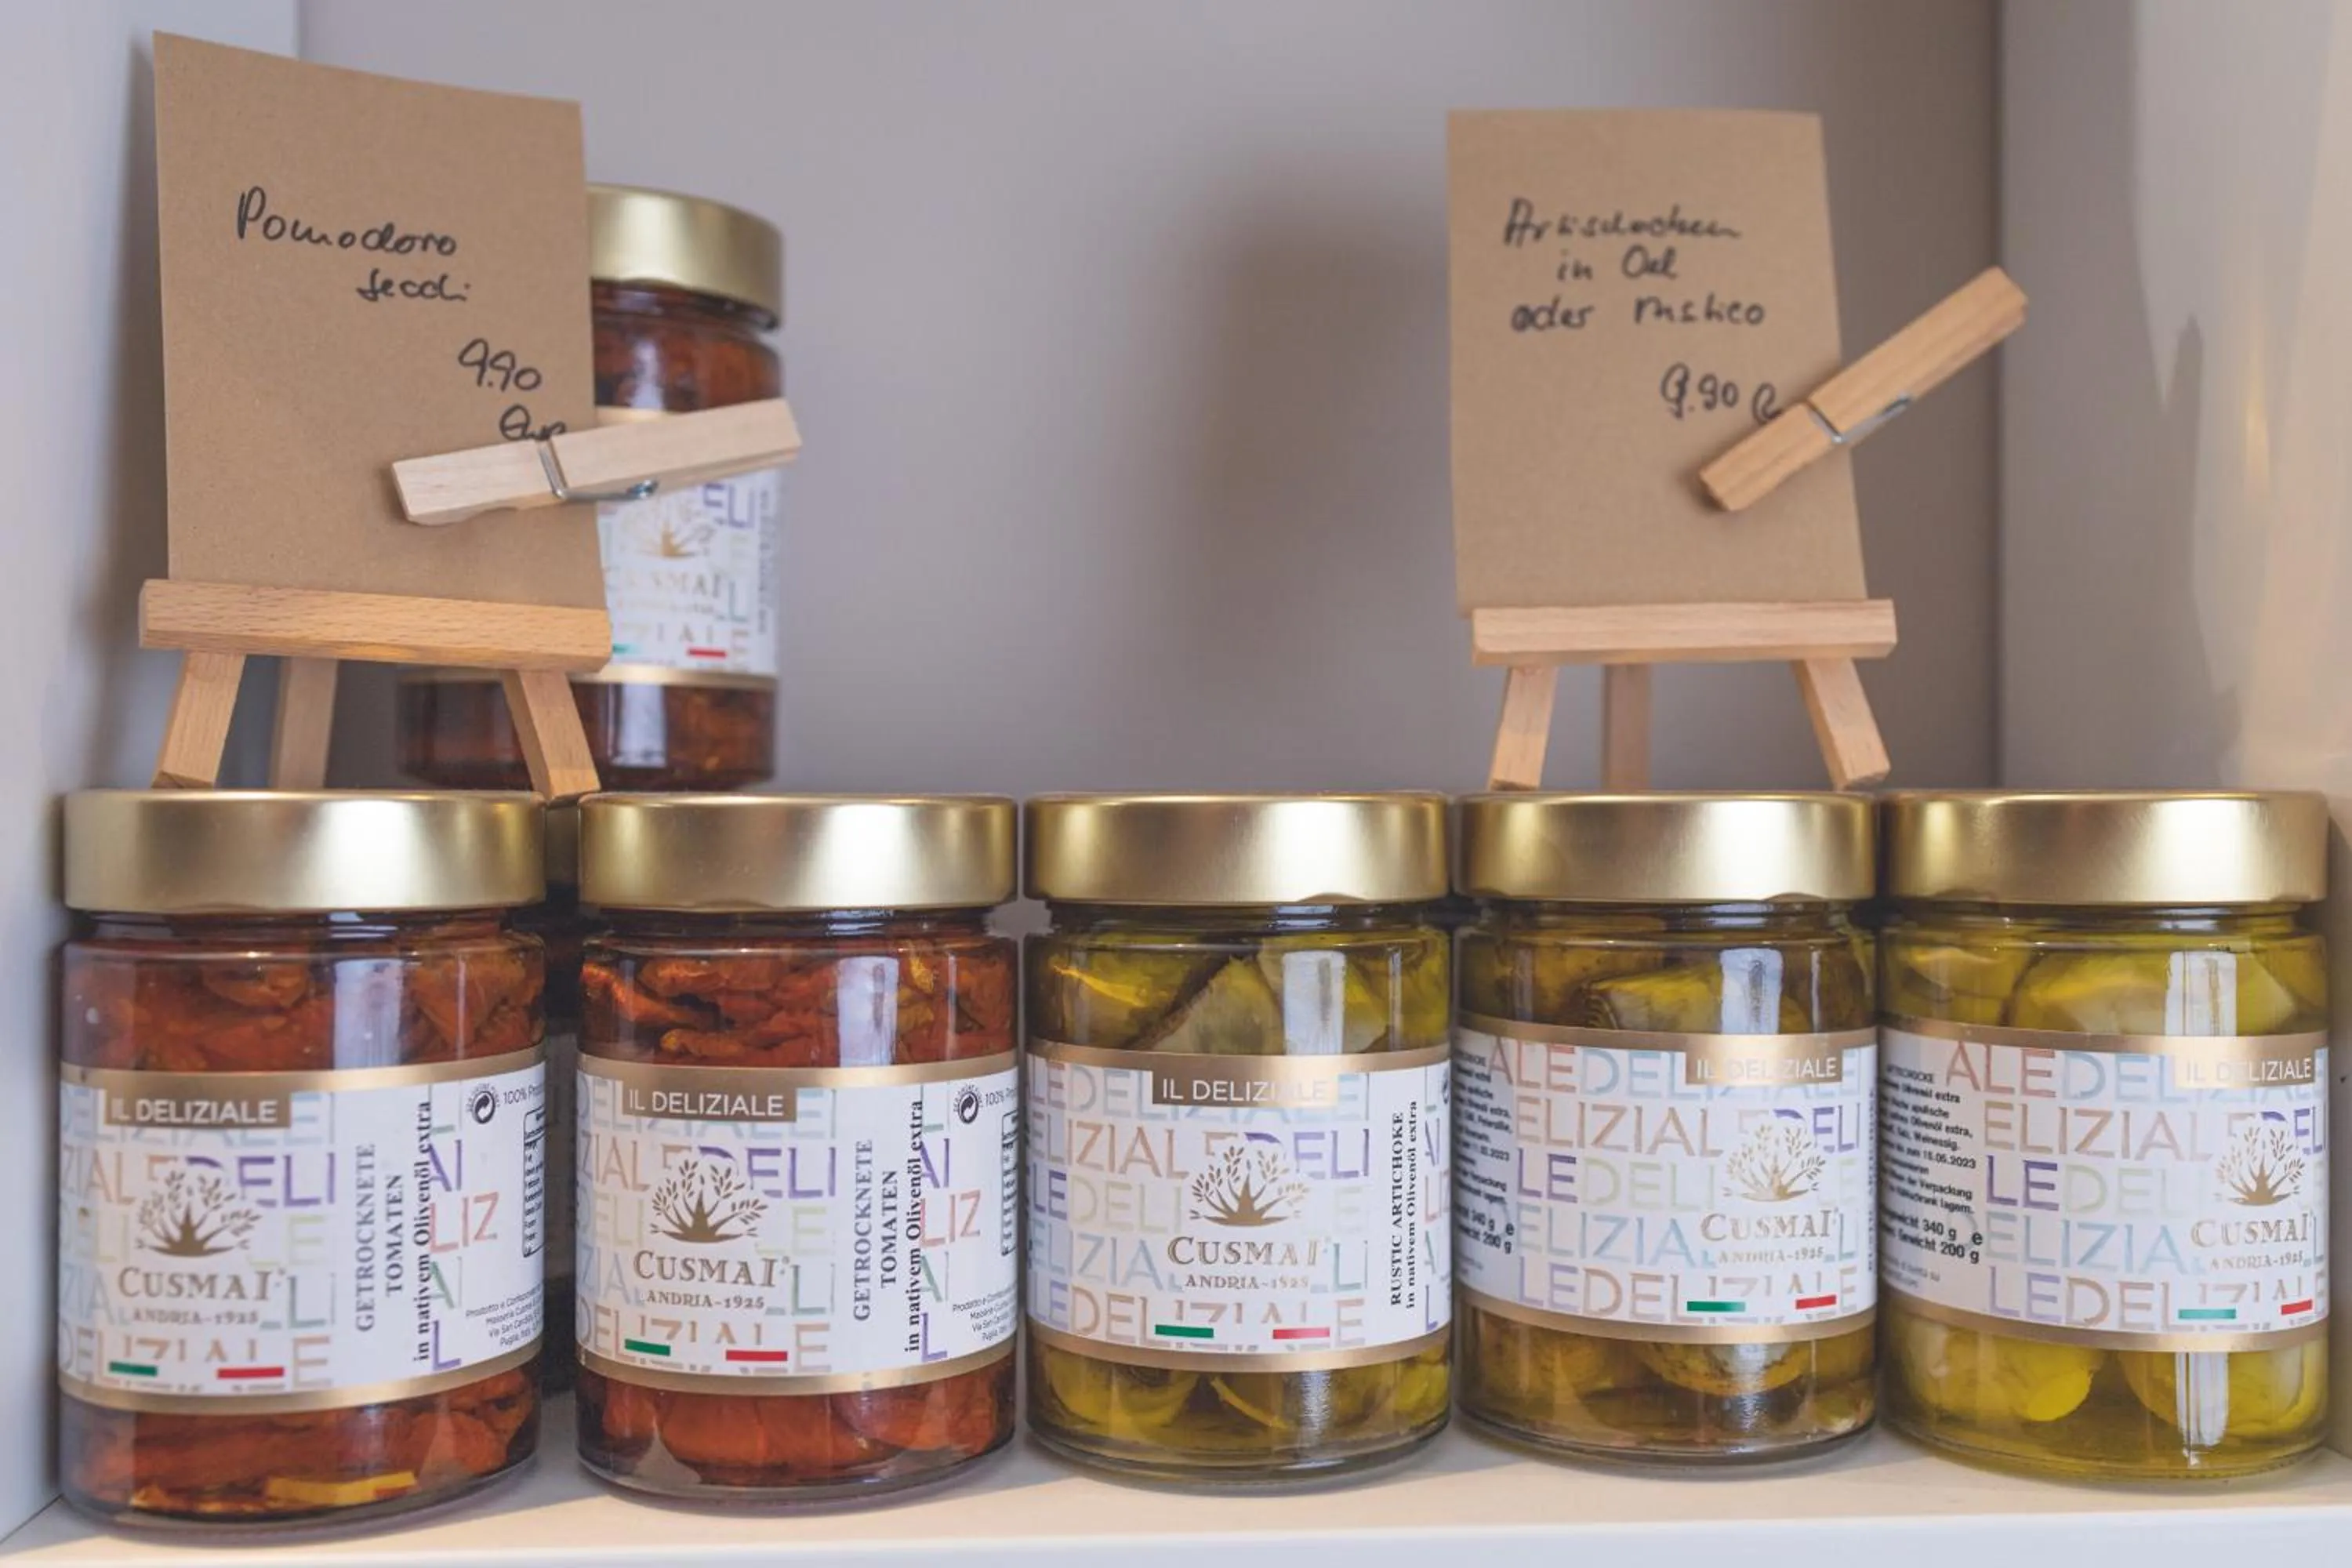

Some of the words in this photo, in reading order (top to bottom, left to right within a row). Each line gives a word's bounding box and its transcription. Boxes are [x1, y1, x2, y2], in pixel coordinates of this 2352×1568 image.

[238, 186, 457, 256] Pomodoro
[1557, 249, 1594, 281] in
[1511, 296, 1594, 332] oder
[457, 337, 543, 392] 9.90
[1661, 361, 1740, 421] 9.90
[1697, 1056, 1714, 1080] IL
[1727, 1057, 1837, 1080] DELZIALE
[2216, 1057, 2312, 1083] DLIZIALE
[629, 1090, 645, 1112] IL
[652, 1091, 784, 1117] DELIZIALE
[1163, 1079, 1184, 1100] IL
[1192, 1080, 1327, 1103] DELIZILE
[111, 1098, 132, 1120] IL
[136, 1098, 278, 1124] DELIZIALE
[415, 1100, 432, 1154] extra
[909, 1099, 924, 1152] extra
[1392, 1112, 1404, 1229] ARTICHOKE
[412, 1160, 432, 1247] Olivenöl
[906, 1157, 923, 1243] Olivenöl
[355, 1142, 376, 1333] GETROCKNETE
[385, 1174, 404, 1298] TOMATEN
[853, 1139, 873, 1322] GETROCKNETE
[880, 1169, 898, 1290] TOMATEN
[1700, 1210, 1832, 1242] CUSMAI
[1922, 1218, 1945, 1237] 340
[1948, 1228, 1958, 1242] g
[1971, 1231, 1984, 1247] e
[2190, 1212, 2309, 1248] CUSMAI
[633, 1250, 779, 1288] CUSMAI
[1167, 1236, 1319, 1267] CUSMAI
[1940, 1241, 1966, 1259] 200
[1969, 1250, 1980, 1265] g
[119, 1266, 272, 1301] CUSMAI
[906, 1247, 922, 1326] nativem
[1390, 1235, 1403, 1307] RUSTIC
[413, 1254, 431, 1330] nativem
[1406, 1292, 1415, 1310] in
[413, 1341, 430, 1362] in
[905, 1332, 920, 1353] in
